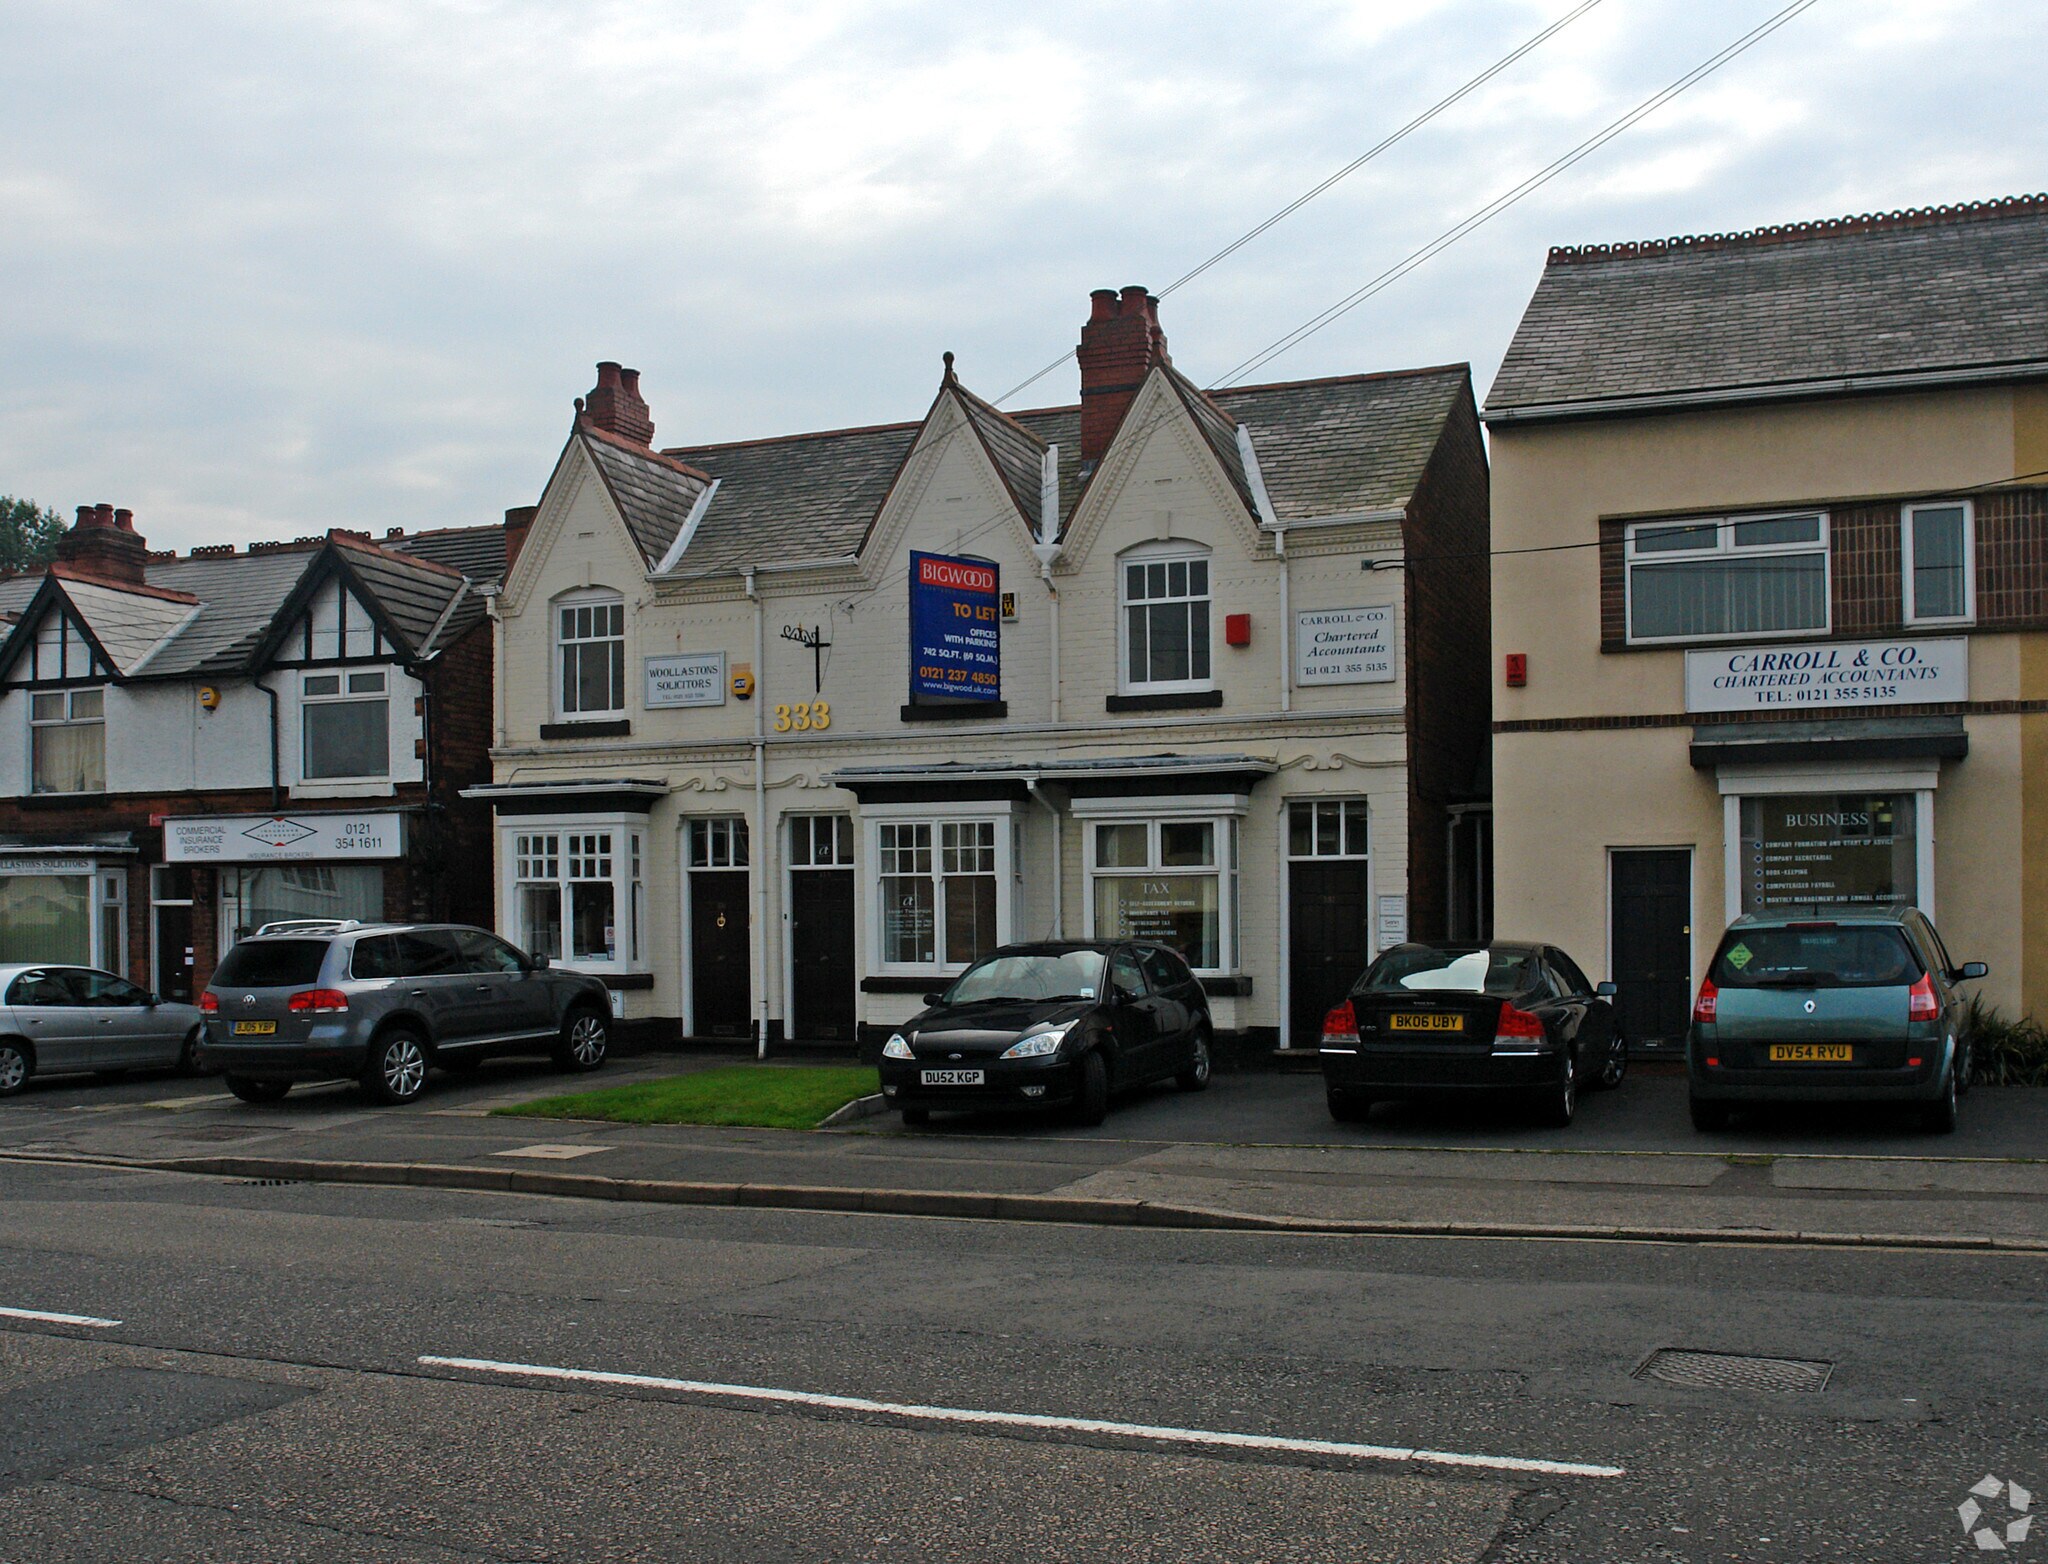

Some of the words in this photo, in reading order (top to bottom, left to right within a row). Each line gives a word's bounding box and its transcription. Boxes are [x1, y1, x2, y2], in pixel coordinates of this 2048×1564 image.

[923, 563, 993, 588] BIGWOOD
[953, 602, 972, 617] TO
[976, 606, 996, 621] LET
[1301, 613, 1354, 625] CARROLL
[1367, 612, 1387, 621] CO.
[970, 628, 997, 639] OFFICES
[1315, 629, 1379, 643] Chartered
[944, 634, 964, 644] WITH
[965, 636, 997, 648] PARKING
[923, 647, 937, 656] 742
[1307, 644, 1386, 657] Accountants
[1728, 650, 1841, 673] CARROLL
[1853, 648, 1869, 667] &
[1881, 646, 1923, 665] CO.
[649, 665, 718, 678] WOOLLASTONS
[1304, 666, 1316, 675] Tel
[1320, 665, 1340, 674] 0121
[1345, 664, 1362, 673] 355
[1366, 662, 1387, 671] 5135
[920, 666, 944, 679] 0121
[947, 669, 967, 682] 237
[971, 672, 997, 685] 4850
[1713, 672, 1810, 689] CHARTERED
[1817, 666, 1939, 685] ACCOUNTANTS
[657, 679, 711, 691] SOLICITORS
[923, 681, 998, 694] www.bigwood.uk.com
[1754, 691, 1792, 704] TEL:
[1796, 688, 1828, 702] 0121
[1834, 687, 1859, 700] 355
[1863, 686, 1896, 699] 5135
[773, 701, 830, 732] 333
[1786, 812, 1869, 827] BUSINESS
[176, 826, 226, 836] COMMERCIAL
[345, 823, 371, 835] 0121
[179, 835, 223, 845] INSURANCE
[335, 838, 354, 849] 354
[359, 837, 382, 848] 1611
[183, 845, 220, 854] BROKERS
[43, 859, 89, 869] SOLICITORS
[1142, 882, 1169, 894] TAX
[1396, 1015, 1429, 1028] BK06
[1432, 1015, 1458, 1028] UBY
[1776, 1046, 1814, 1059] DV54
[1818, 1046, 1846, 1059] RYU
[925, 1072, 954, 1083] DU52
[957, 1072, 979, 1083] KGP
